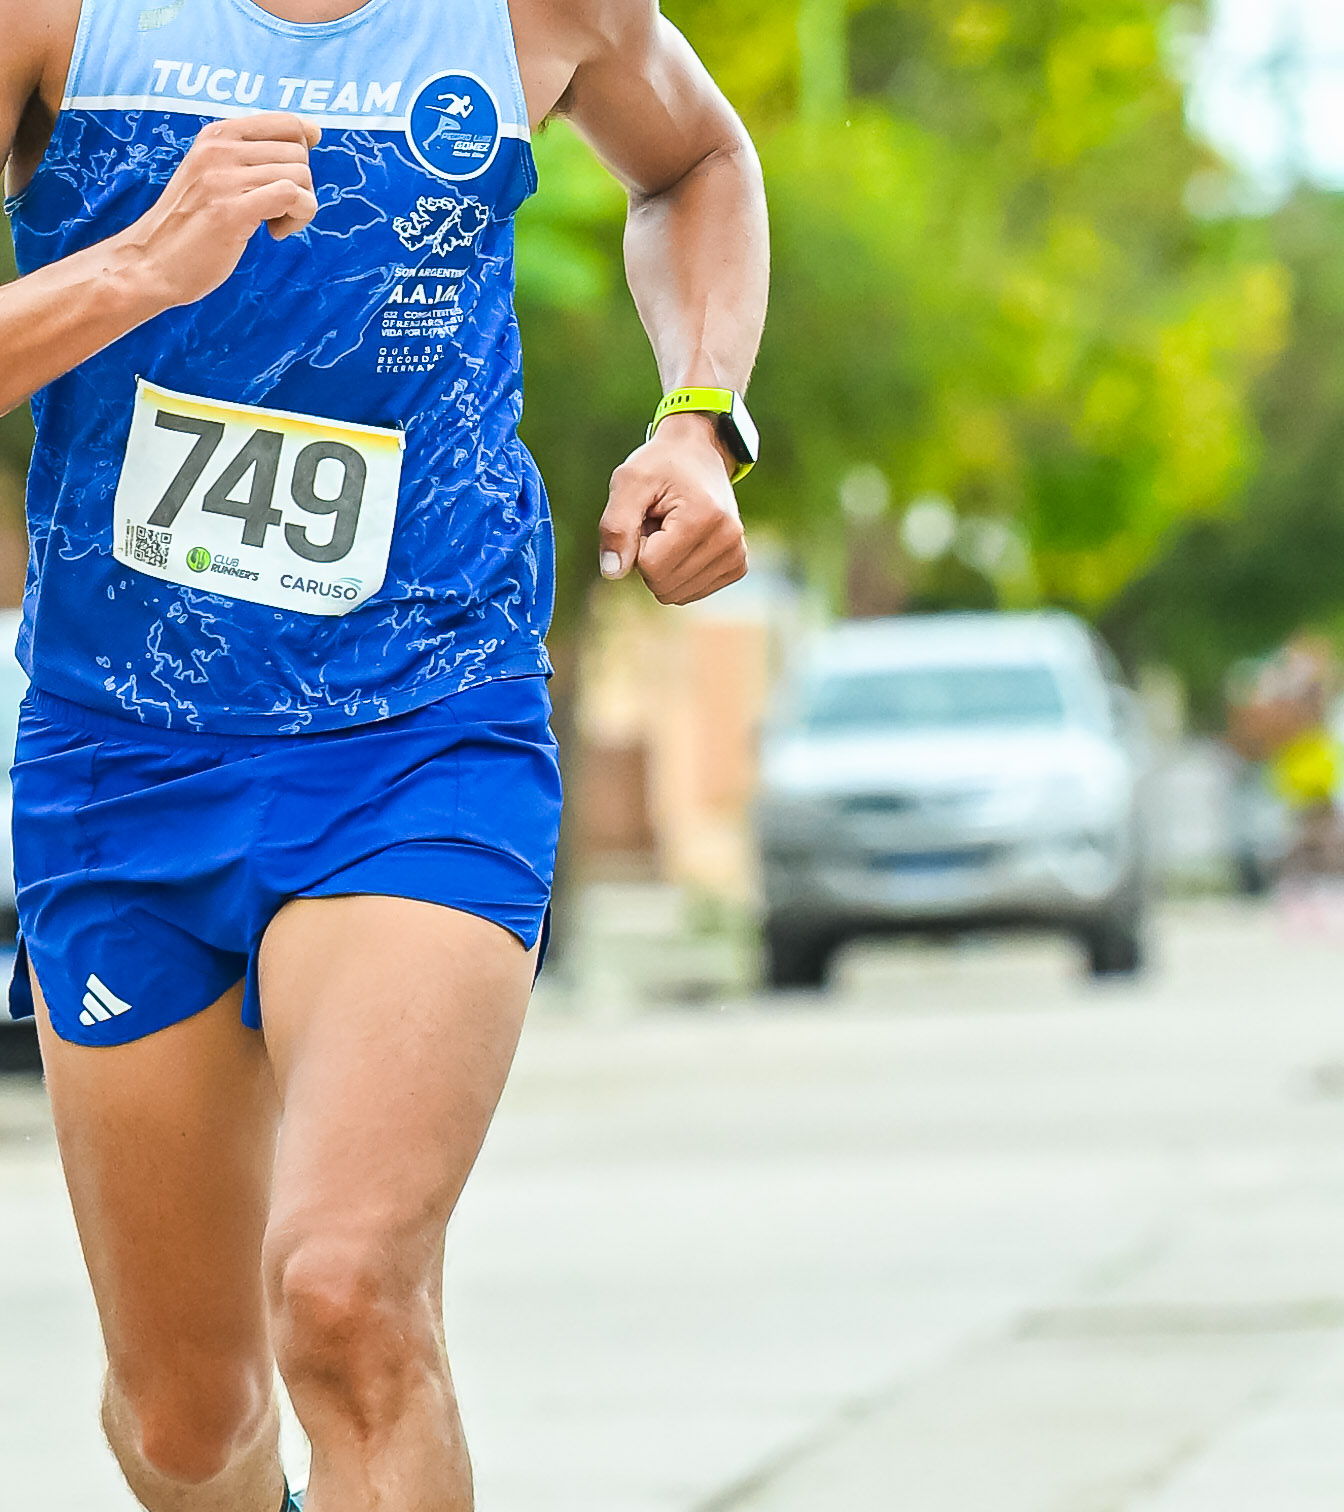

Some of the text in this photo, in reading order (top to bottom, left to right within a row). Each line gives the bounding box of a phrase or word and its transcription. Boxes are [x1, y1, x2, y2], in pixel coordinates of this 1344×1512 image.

[153, 59, 402, 113] TUCU TEAM
[454, 140, 491, 152] GOMEZ
[395, 267, 417, 278] SON
[381, 328, 403, 337] VIDA
[147, 410, 367, 563] 749
[213, 554, 240, 568] CLUB
[280, 574, 358, 601] CARUSO
